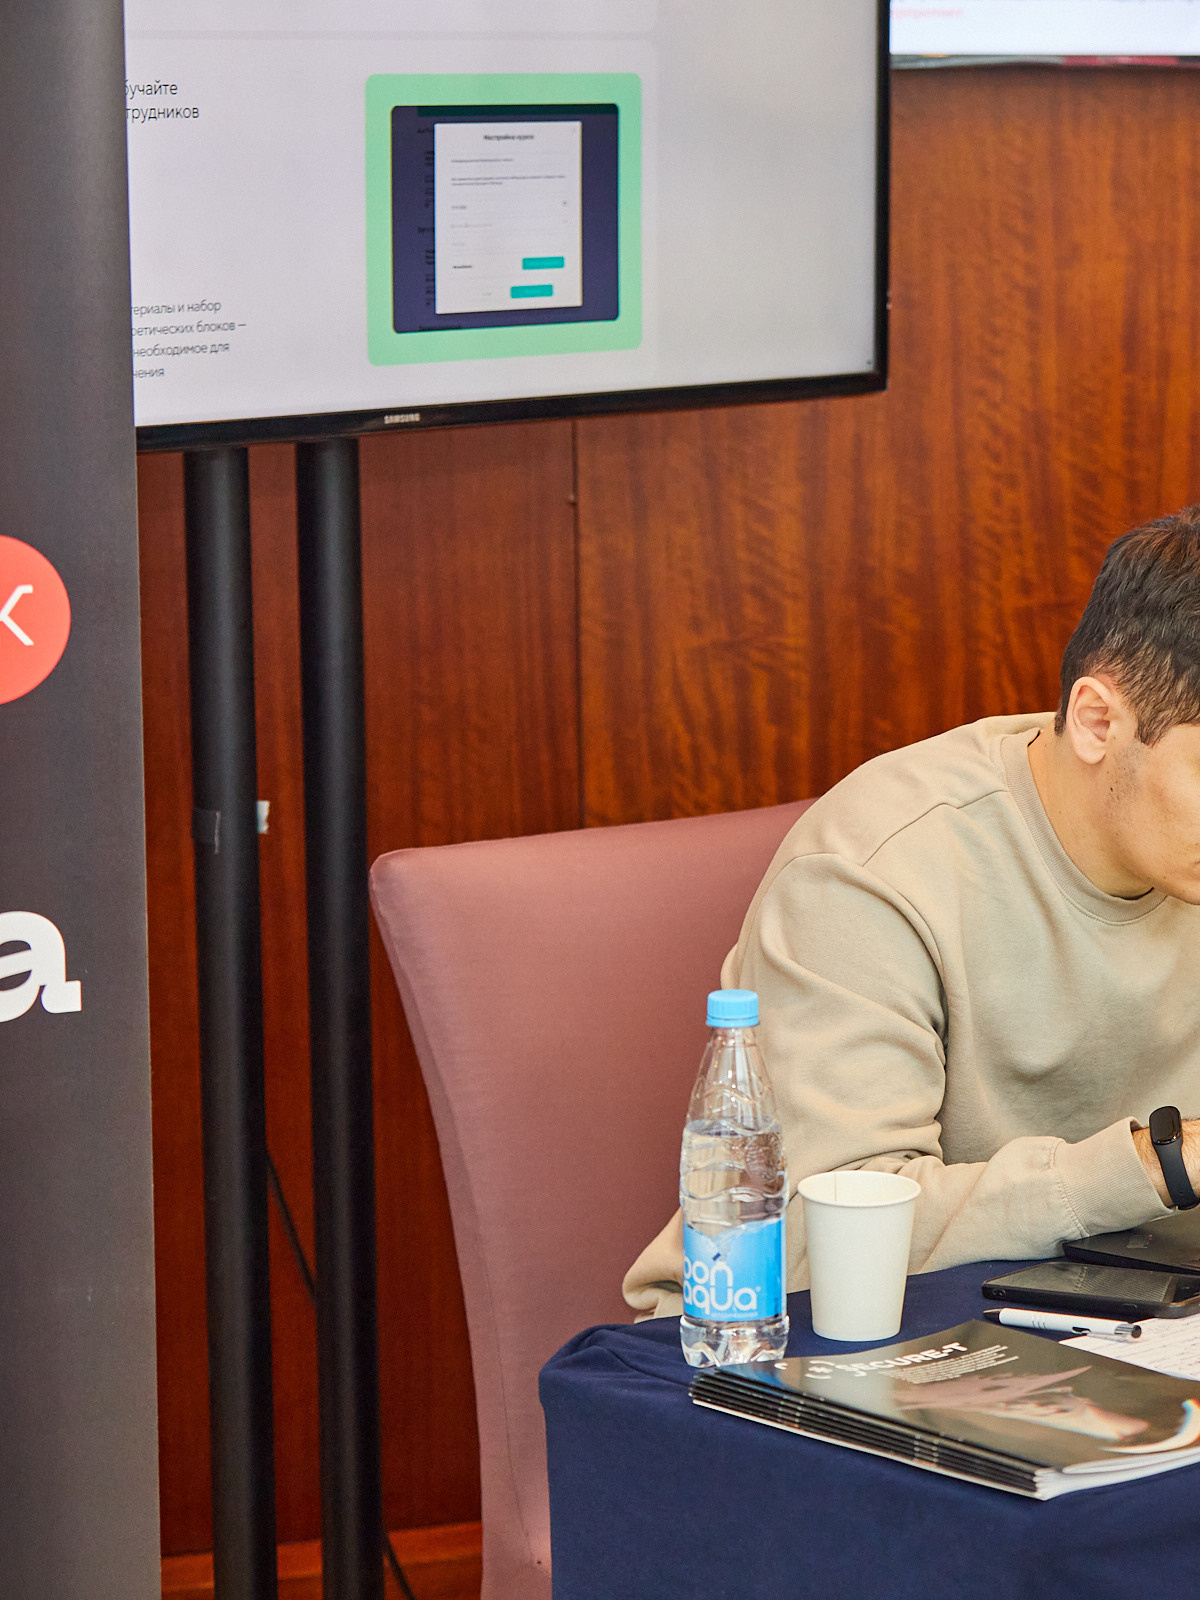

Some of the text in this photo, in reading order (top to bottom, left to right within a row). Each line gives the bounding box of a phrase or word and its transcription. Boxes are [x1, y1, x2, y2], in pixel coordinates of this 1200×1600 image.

[177, 303, 185, 313] и
[187, 299, 222, 313] набор
[196, 320, 236, 333] блоков
[209, 343, 230, 353] для
[384, 413, 421, 424] SAMSUNG
[835, 1342, 968, 1377] SECURE-T
